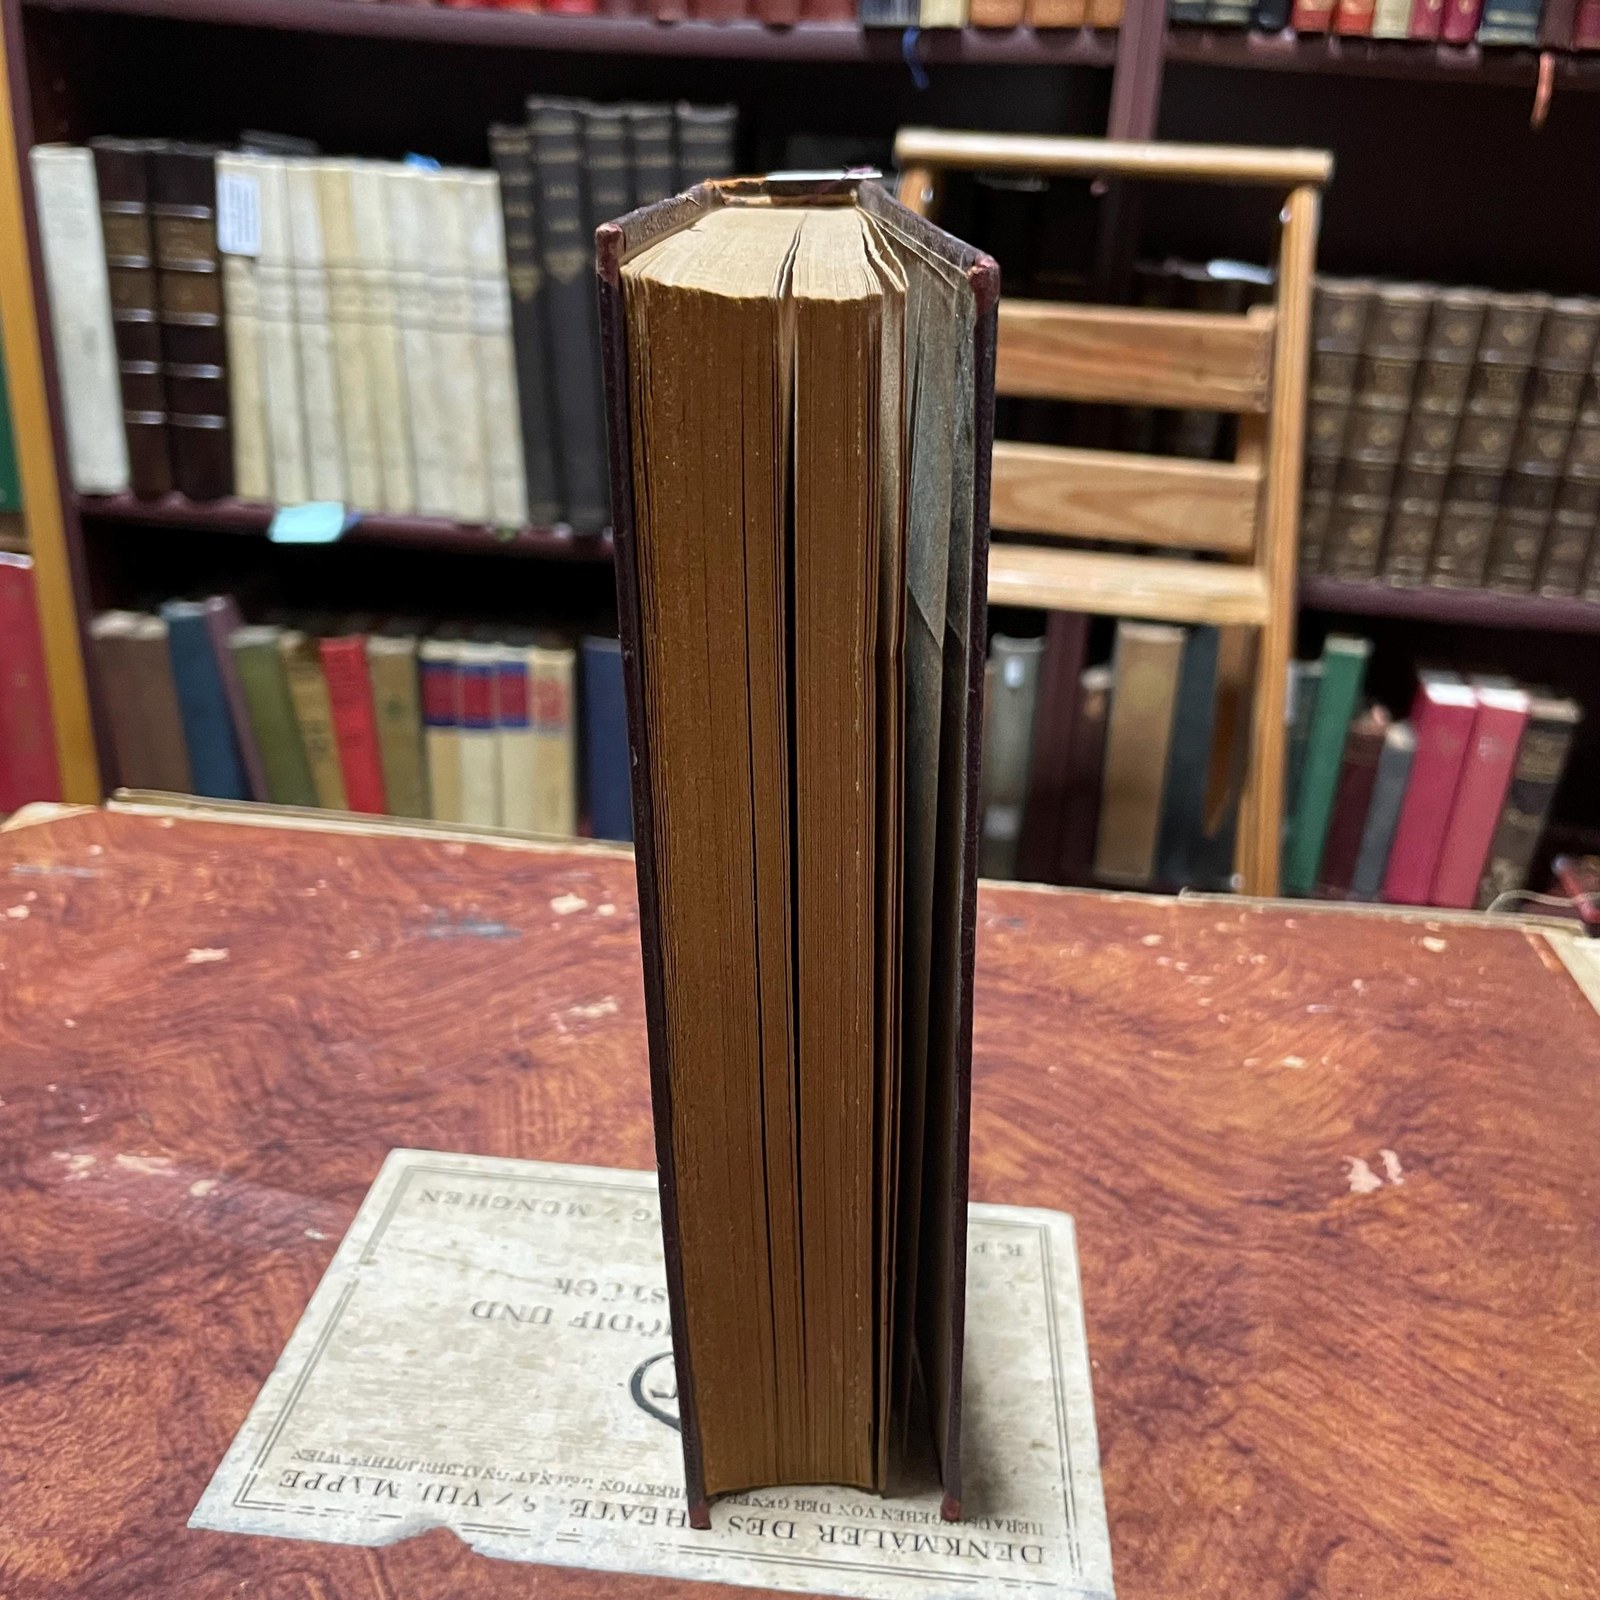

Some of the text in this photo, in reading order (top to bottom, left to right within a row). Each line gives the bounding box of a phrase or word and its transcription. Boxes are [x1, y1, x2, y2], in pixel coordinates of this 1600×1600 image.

[471, 1299, 554, 1326] UND
[279, 1469, 402, 1500] MAPPE
[794, 1499, 832, 1516] DER
[838, 1504, 875, 1519] VON
[726, 1515, 797, 1540] DES
[815, 1523, 1045, 1565] DENKMÄLER
